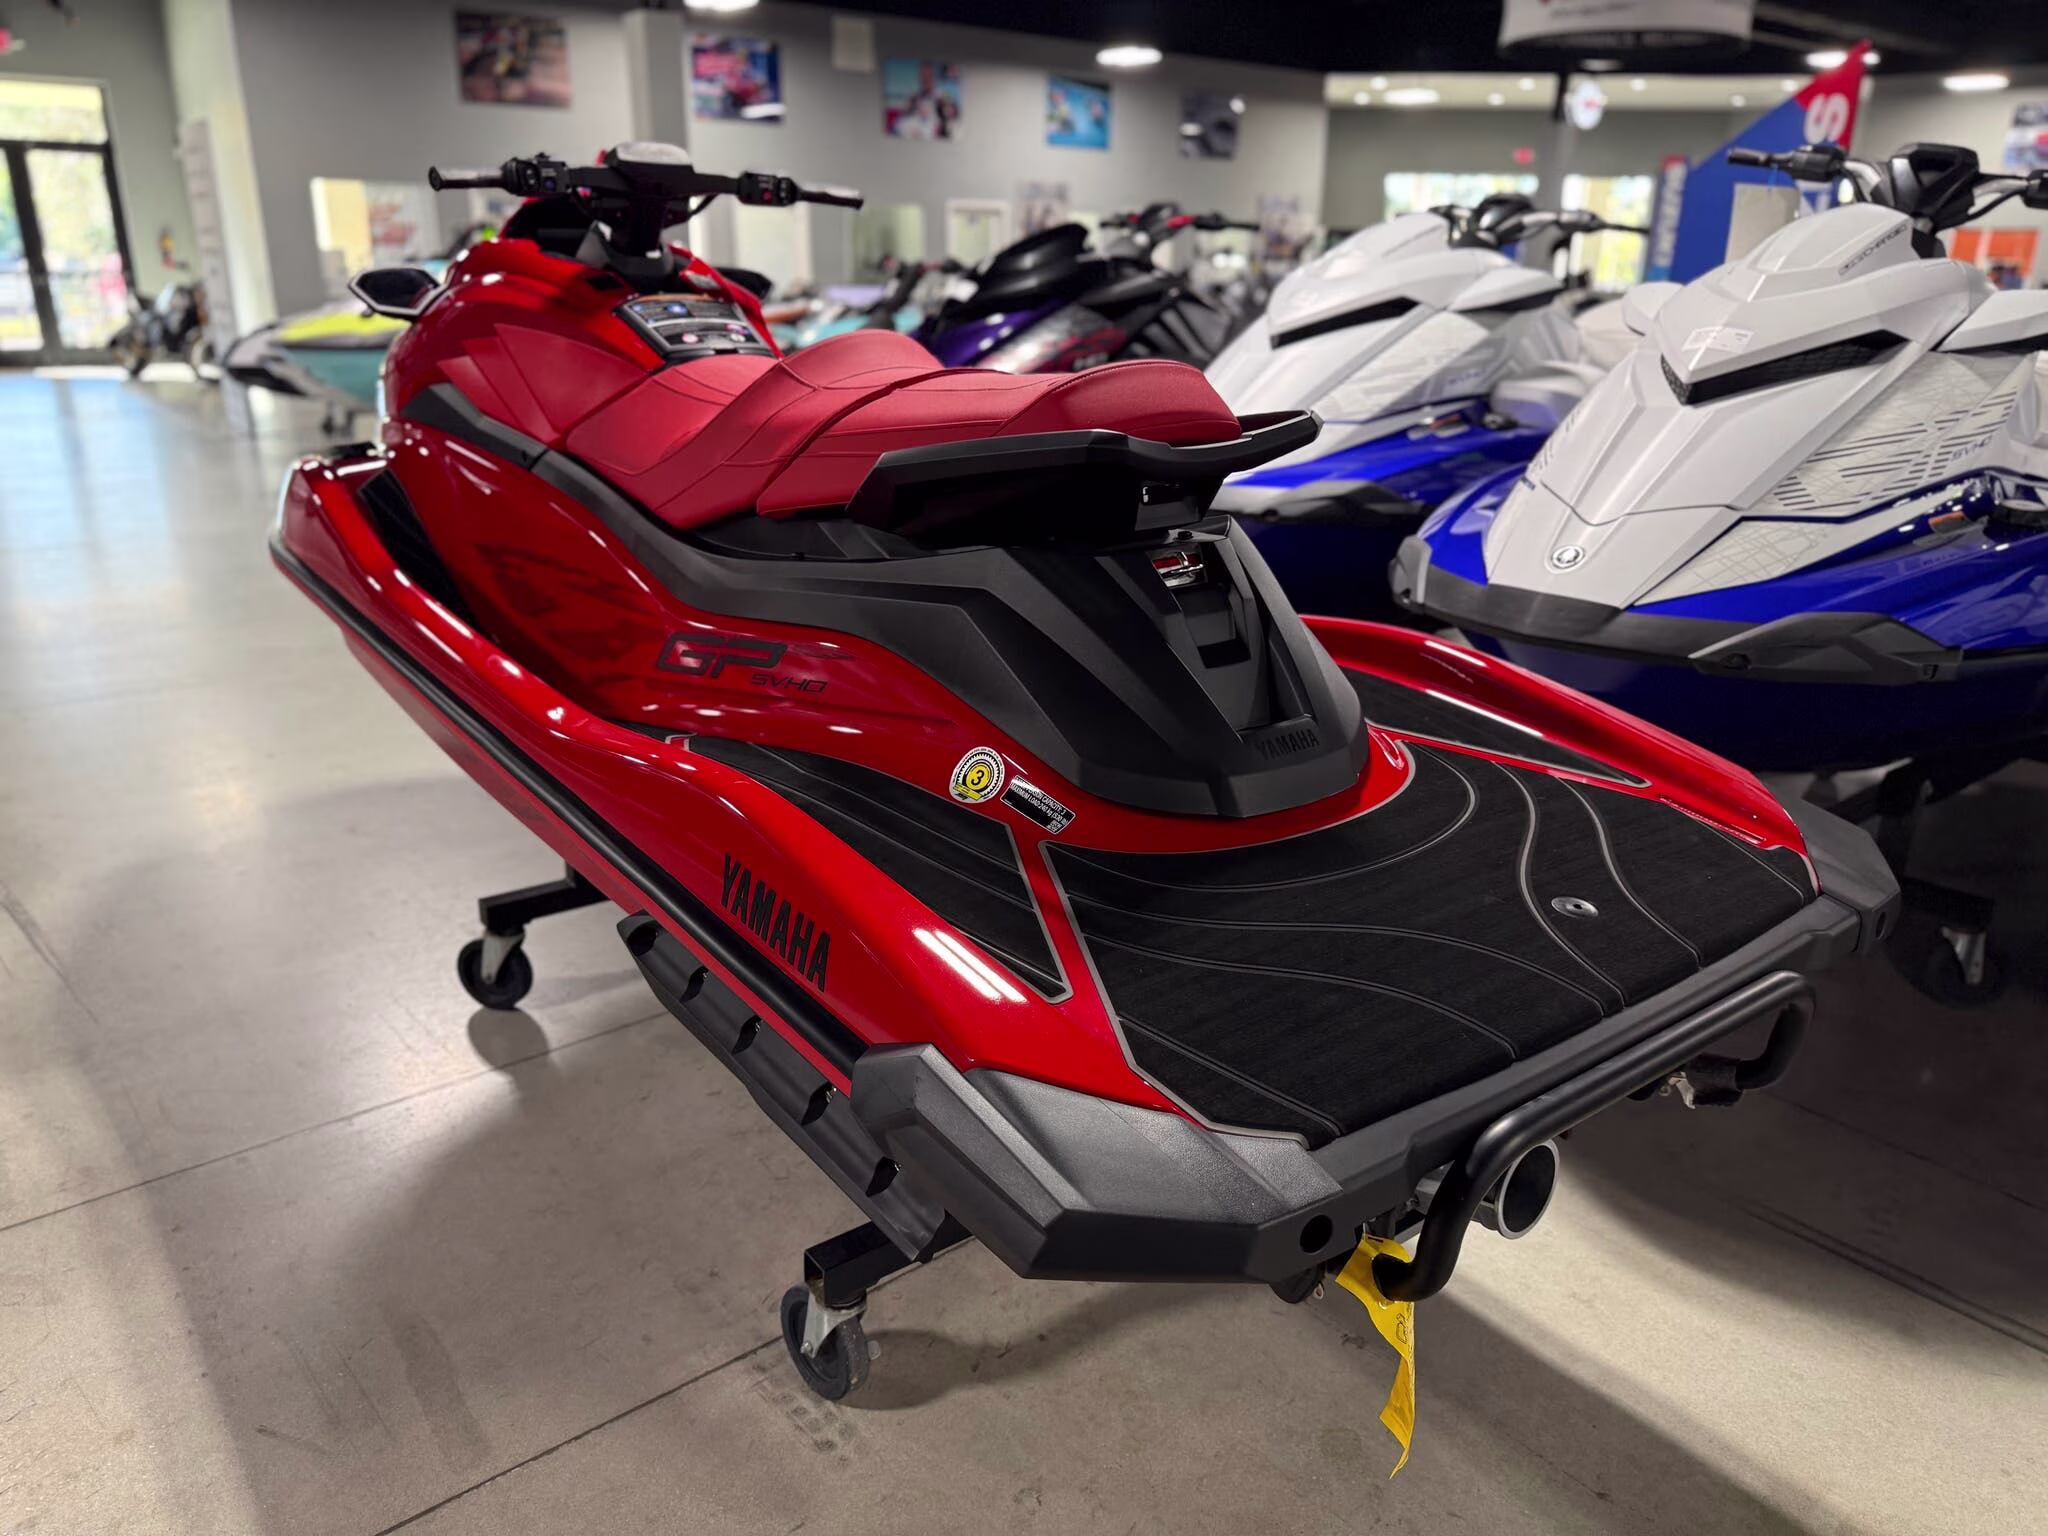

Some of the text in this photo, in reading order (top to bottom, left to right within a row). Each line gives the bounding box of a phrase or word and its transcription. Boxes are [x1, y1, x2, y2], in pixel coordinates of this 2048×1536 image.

[656, 633, 788, 679] GP
[751, 673, 828, 693] SVHO
[1254, 728, 1321, 761] YAMAHA
[970, 769, 985, 786] 3
[720, 852, 831, 993] YAMAHA
